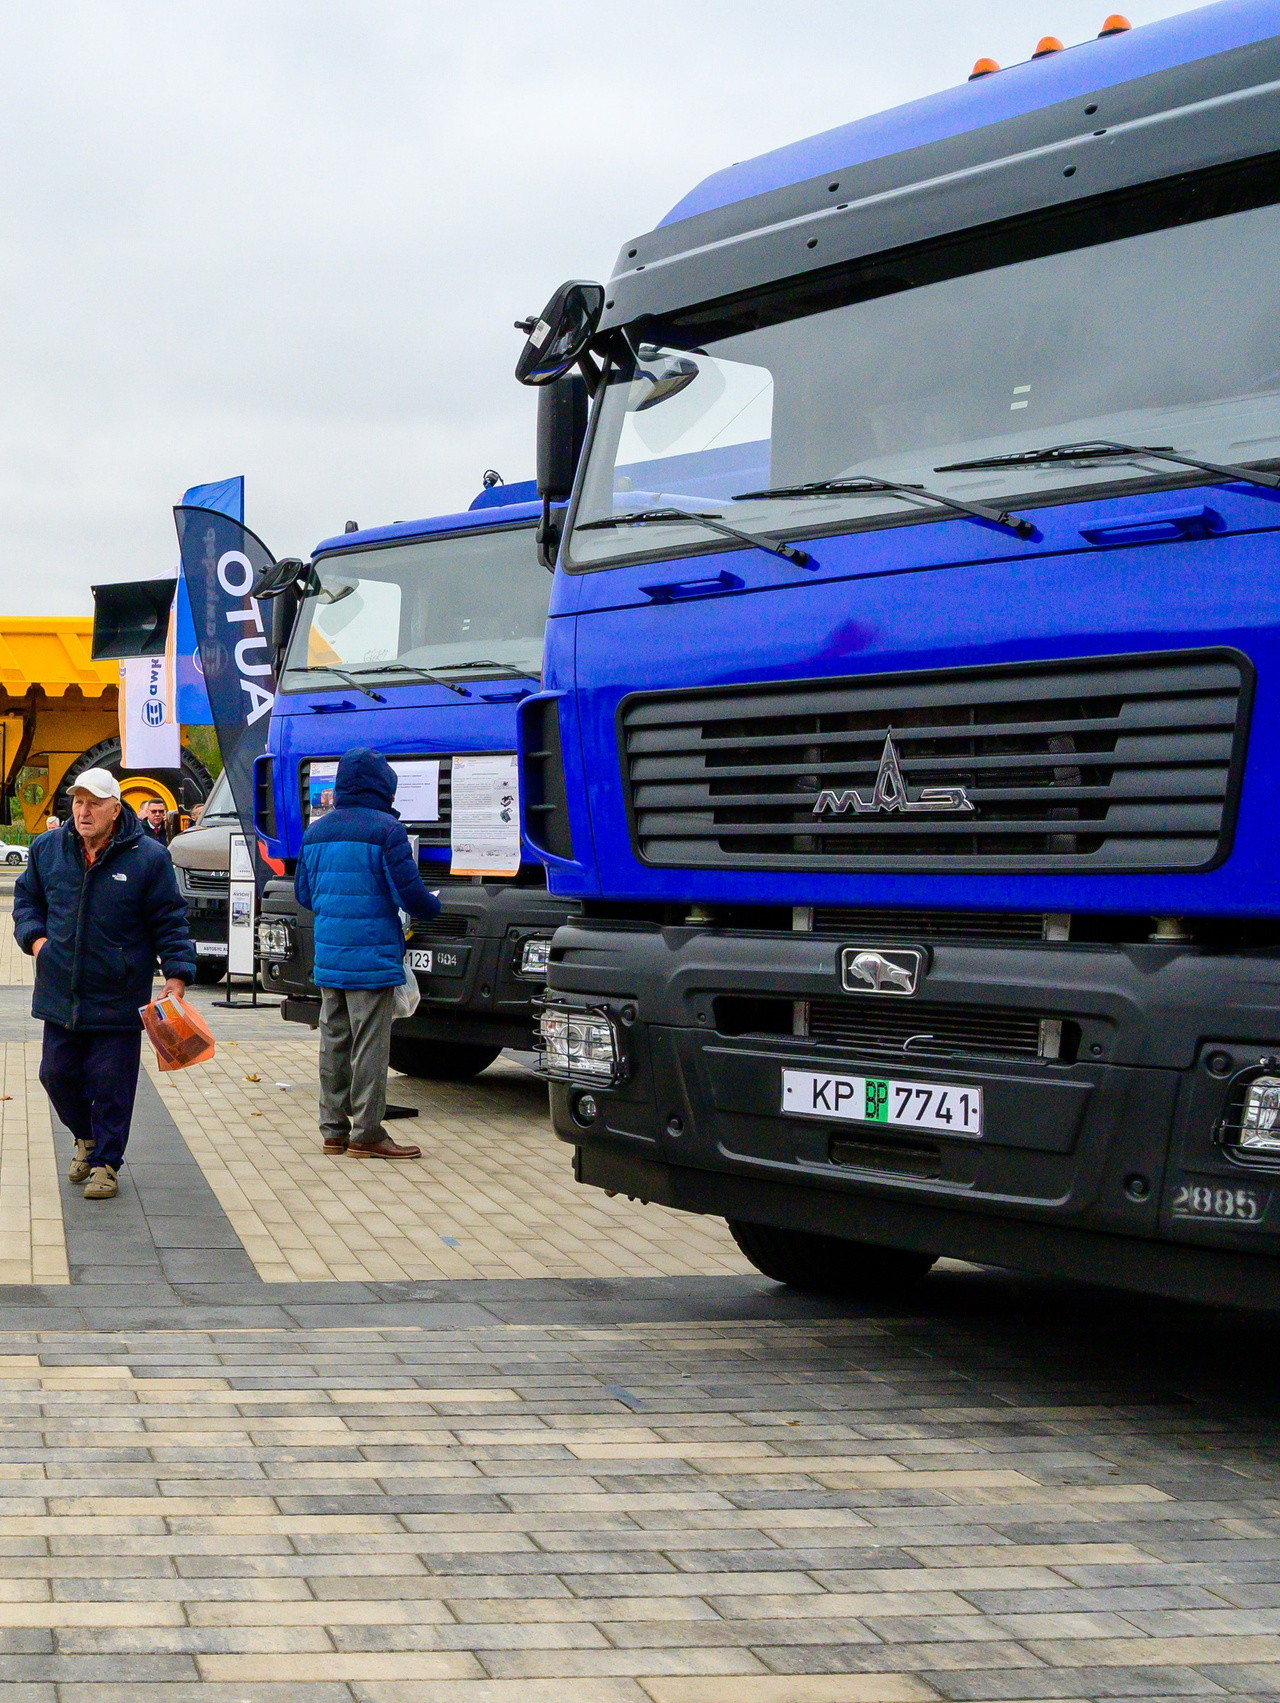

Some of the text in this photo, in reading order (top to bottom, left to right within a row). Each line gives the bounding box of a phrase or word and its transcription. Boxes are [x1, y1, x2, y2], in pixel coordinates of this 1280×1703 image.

[812, 724, 976, 815] МАЗ
[407, 951, 430, 969] 123
[812, 1078, 854, 1111] KP
[895, 1087, 969, 1126] 7741
